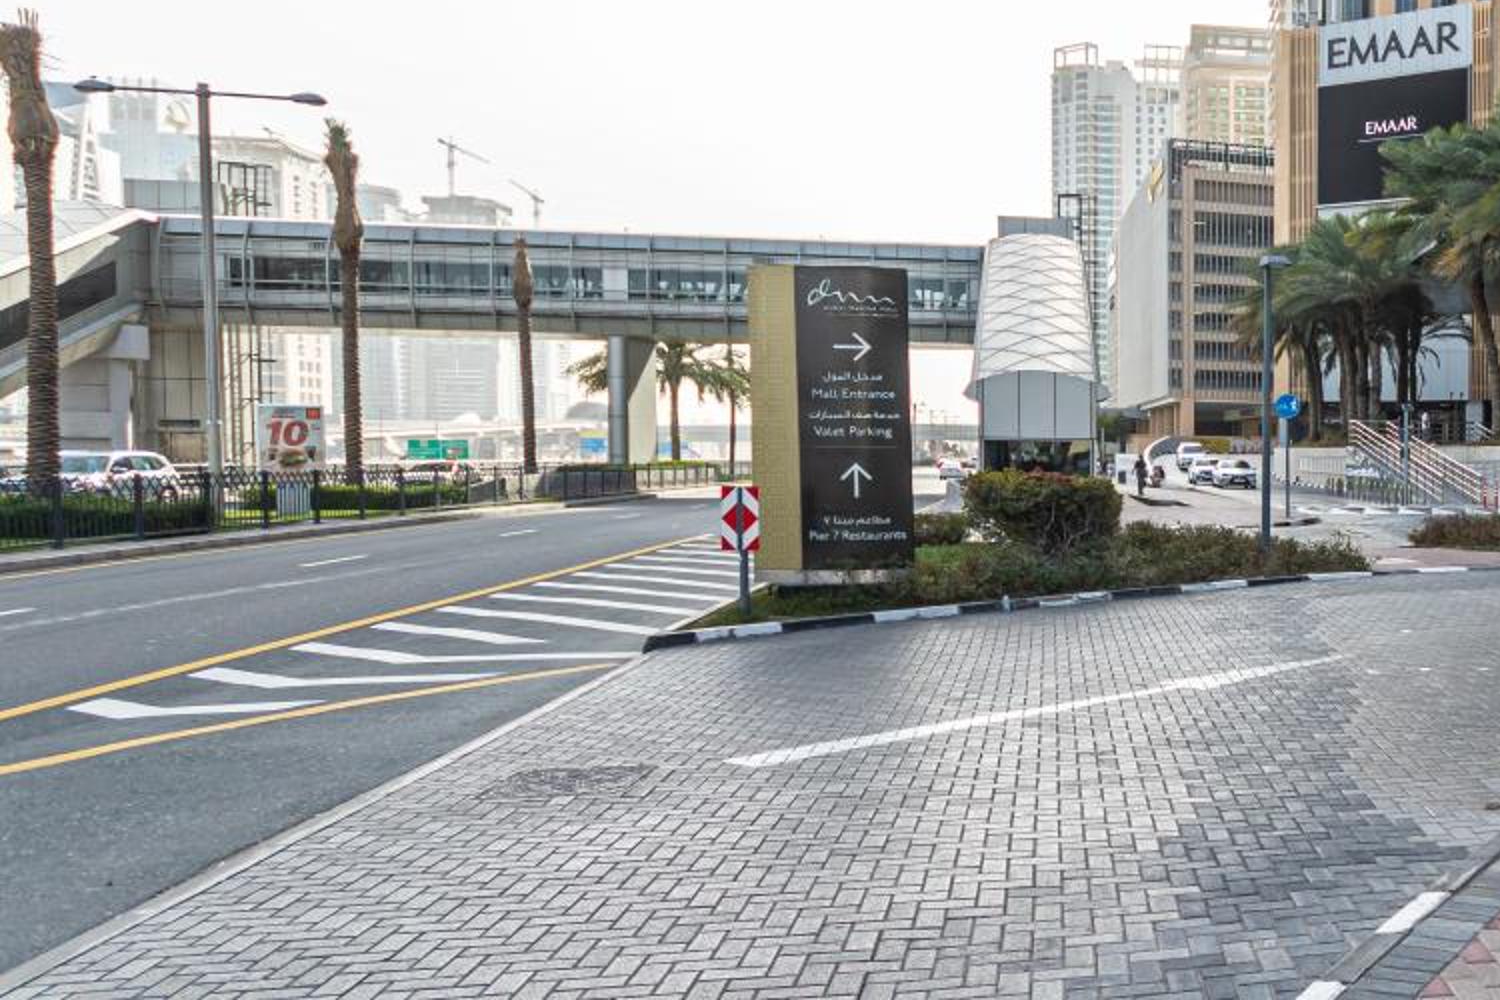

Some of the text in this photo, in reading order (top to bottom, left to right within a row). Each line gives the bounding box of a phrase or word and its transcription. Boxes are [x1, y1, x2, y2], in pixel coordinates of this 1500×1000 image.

[1328, 21, 1460, 70] EMAAR
[1365, 116, 1417, 136] EMAAR
[811, 387, 897, 400] Mall Entrance
[267, 419, 310, 447] 10
[813, 425, 894, 439] Valet Parking
[809, 530, 829, 541] Pier
[841, 530, 907, 541] Restaurants
